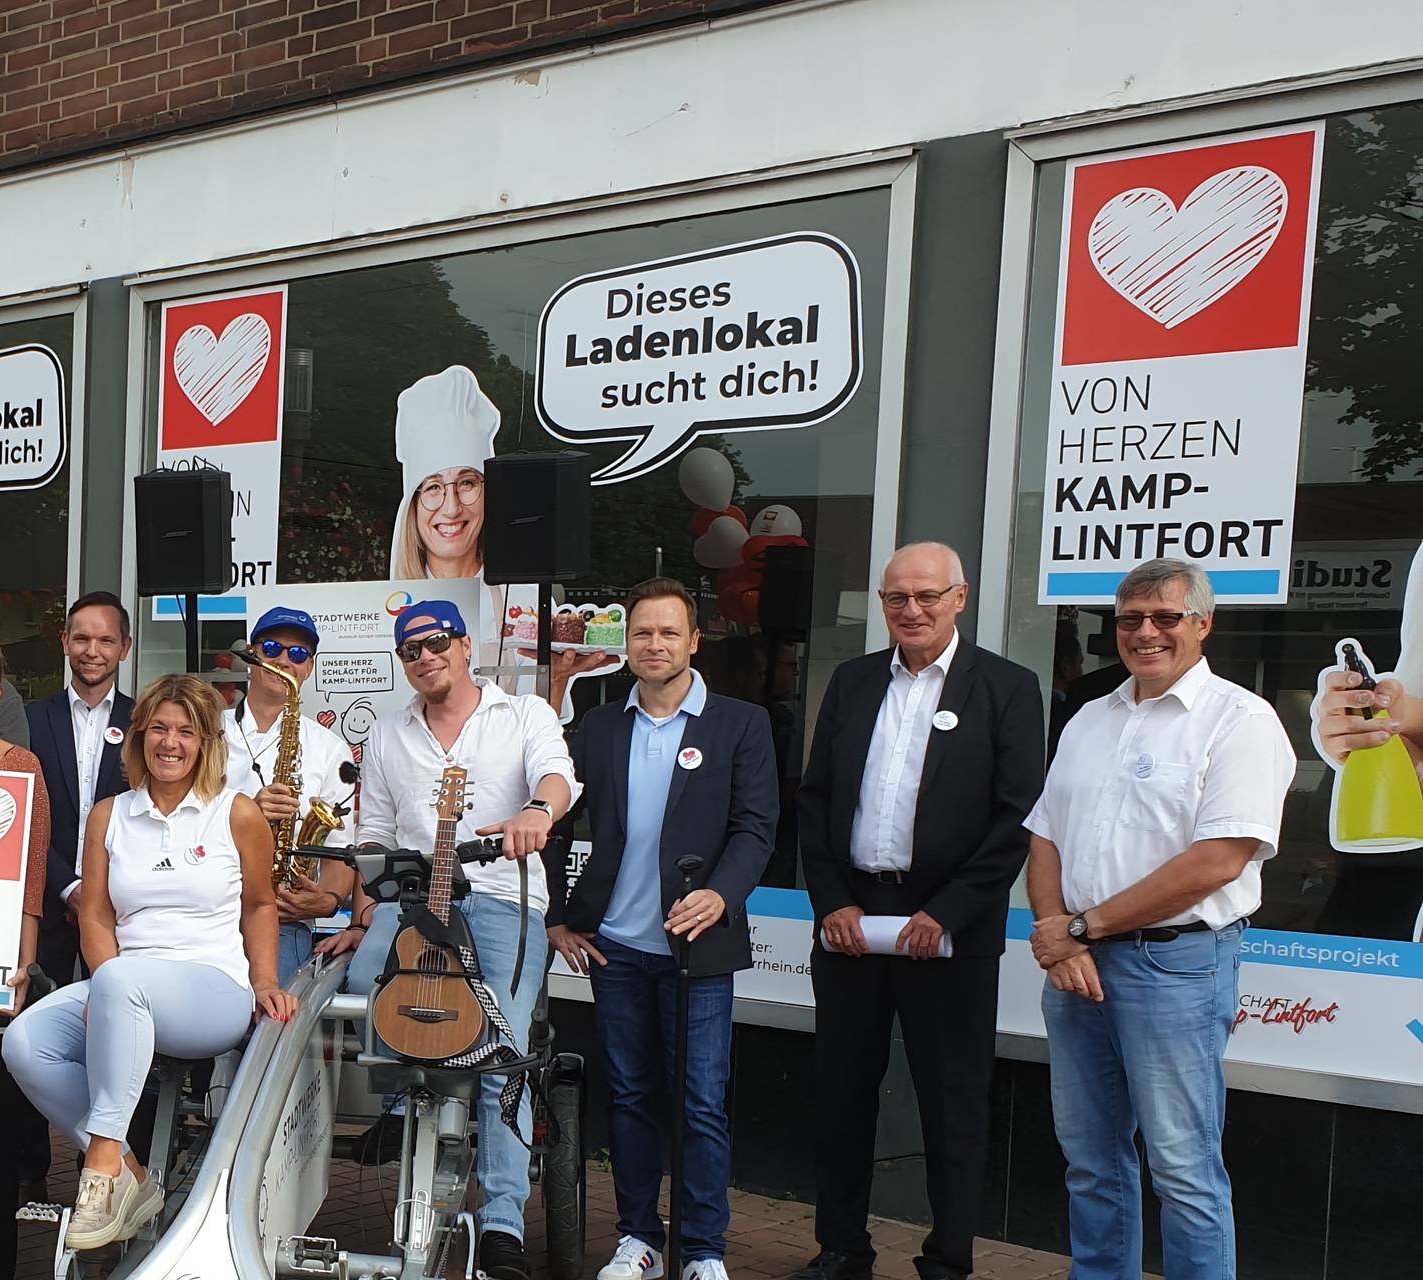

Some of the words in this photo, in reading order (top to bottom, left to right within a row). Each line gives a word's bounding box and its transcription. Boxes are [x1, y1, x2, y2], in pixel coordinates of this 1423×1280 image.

[607, 279, 732, 320] Dieses
[566, 305, 820, 368] Ladenlokal
[600, 371, 707, 409] sucht
[718, 359, 819, 399] dich!
[1060, 374, 1151, 416] VON
[1059, 419, 1242, 464] HERZEN
[1054, 472, 1209, 513] KAMP-
[1051, 519, 1283, 561] LINTFORT
[312, 612, 380, 623] STADTWERKE
[322, 659, 349, 667] UNSER
[322, 667, 359, 676] SCHLÄGT
[361, 667, 378, 675] FÜR
[322, 676, 388, 685] KAMP-LINTFORT
[283, 1070, 321, 1145] STADTWERKE
